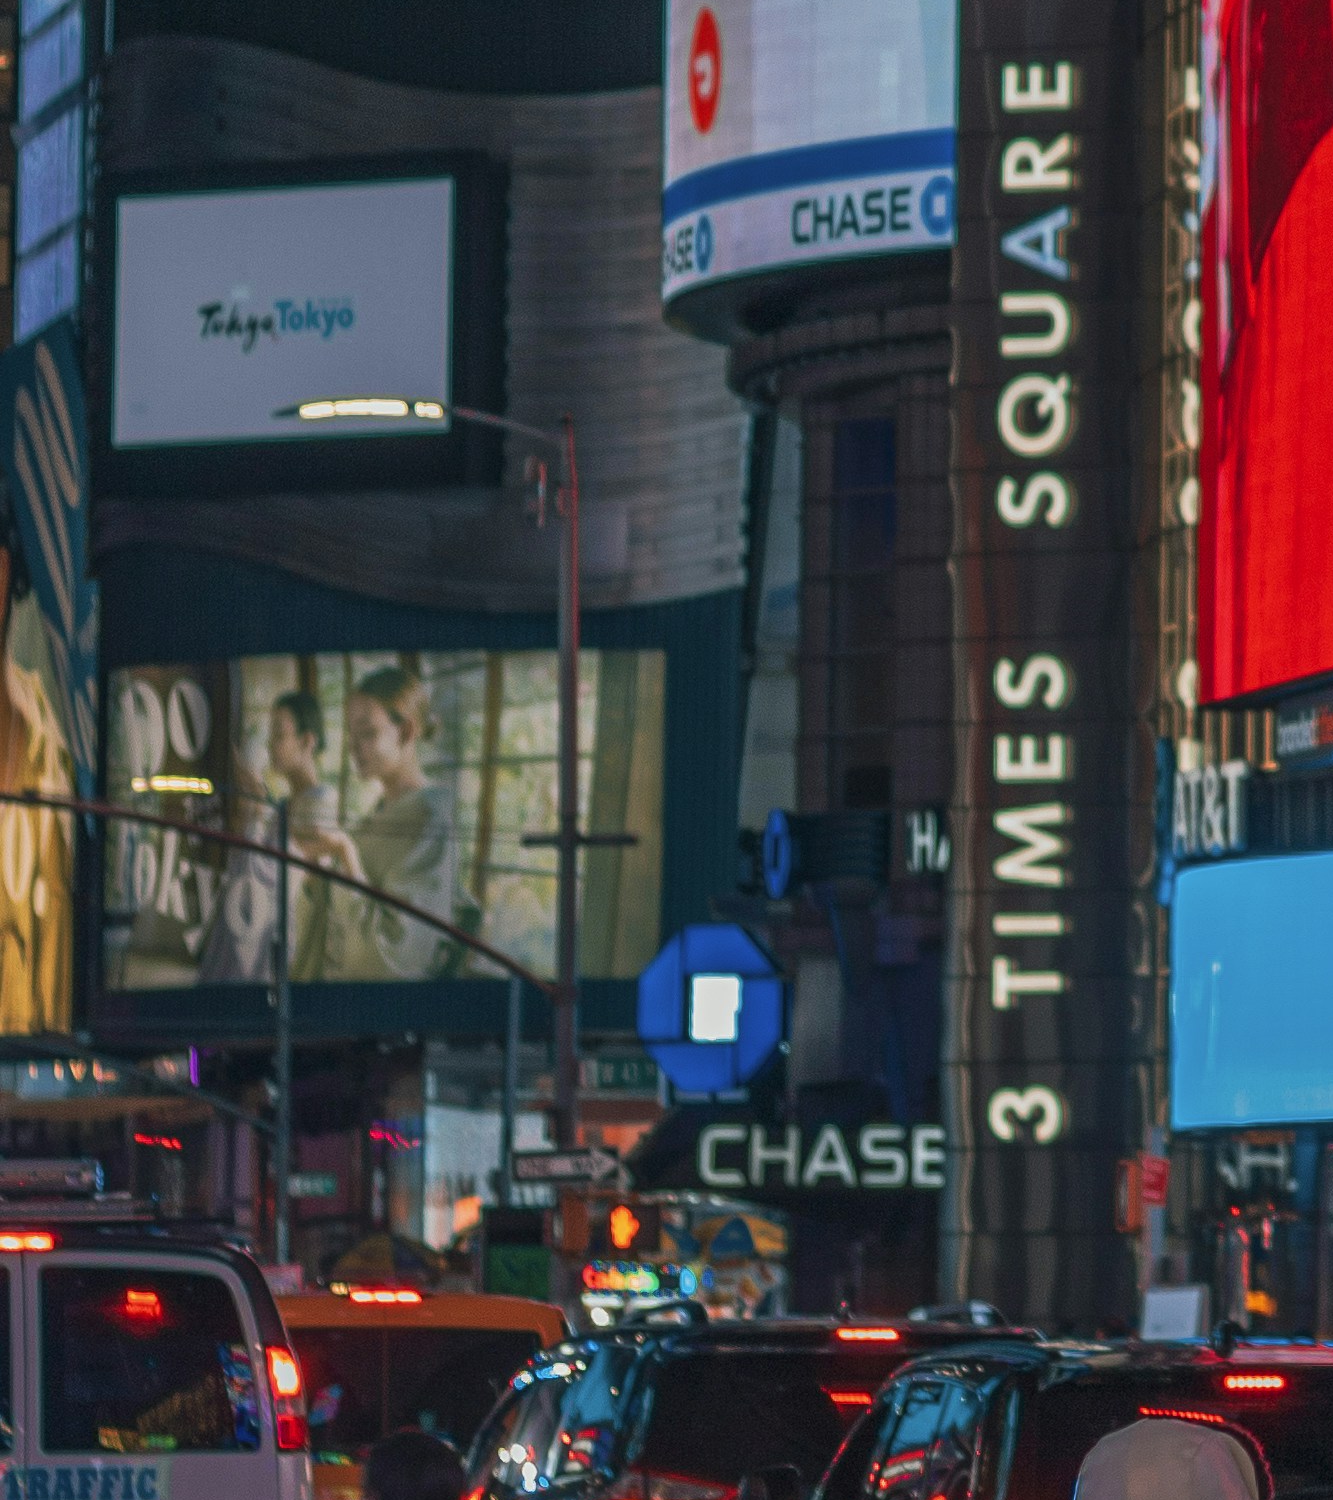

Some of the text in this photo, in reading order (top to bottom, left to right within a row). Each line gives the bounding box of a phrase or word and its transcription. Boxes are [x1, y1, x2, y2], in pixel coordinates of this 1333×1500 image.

[791, 185, 911, 246] CHASE
[275, 299, 354, 339] Tokyo
[987, 61, 1074, 1145] 3 TIMES SQUARE
[697, 1123, 947, 1190] CHASE
